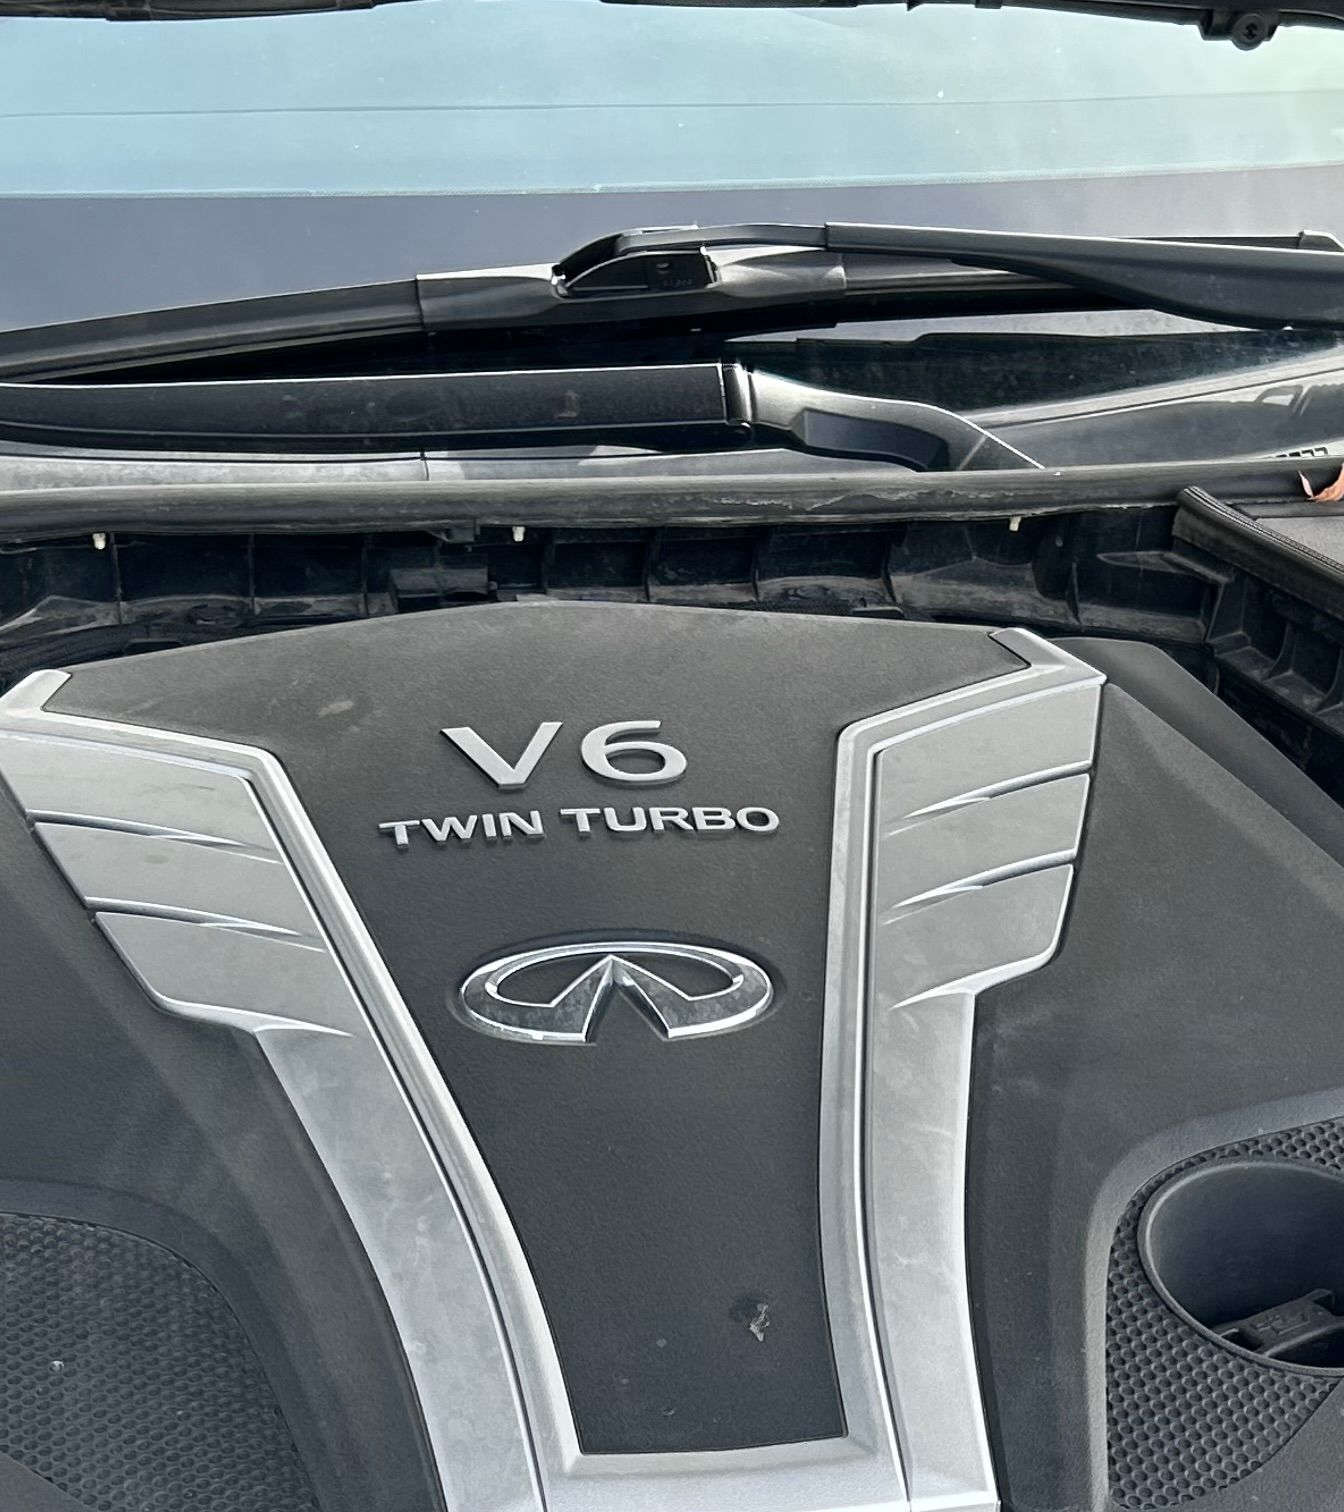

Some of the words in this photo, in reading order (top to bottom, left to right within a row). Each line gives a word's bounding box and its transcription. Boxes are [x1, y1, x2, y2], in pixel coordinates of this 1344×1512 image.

[441, 720, 687, 790] V6
[378, 810, 545, 849] TWIN
[560, 806, 780, 834] TURBO
